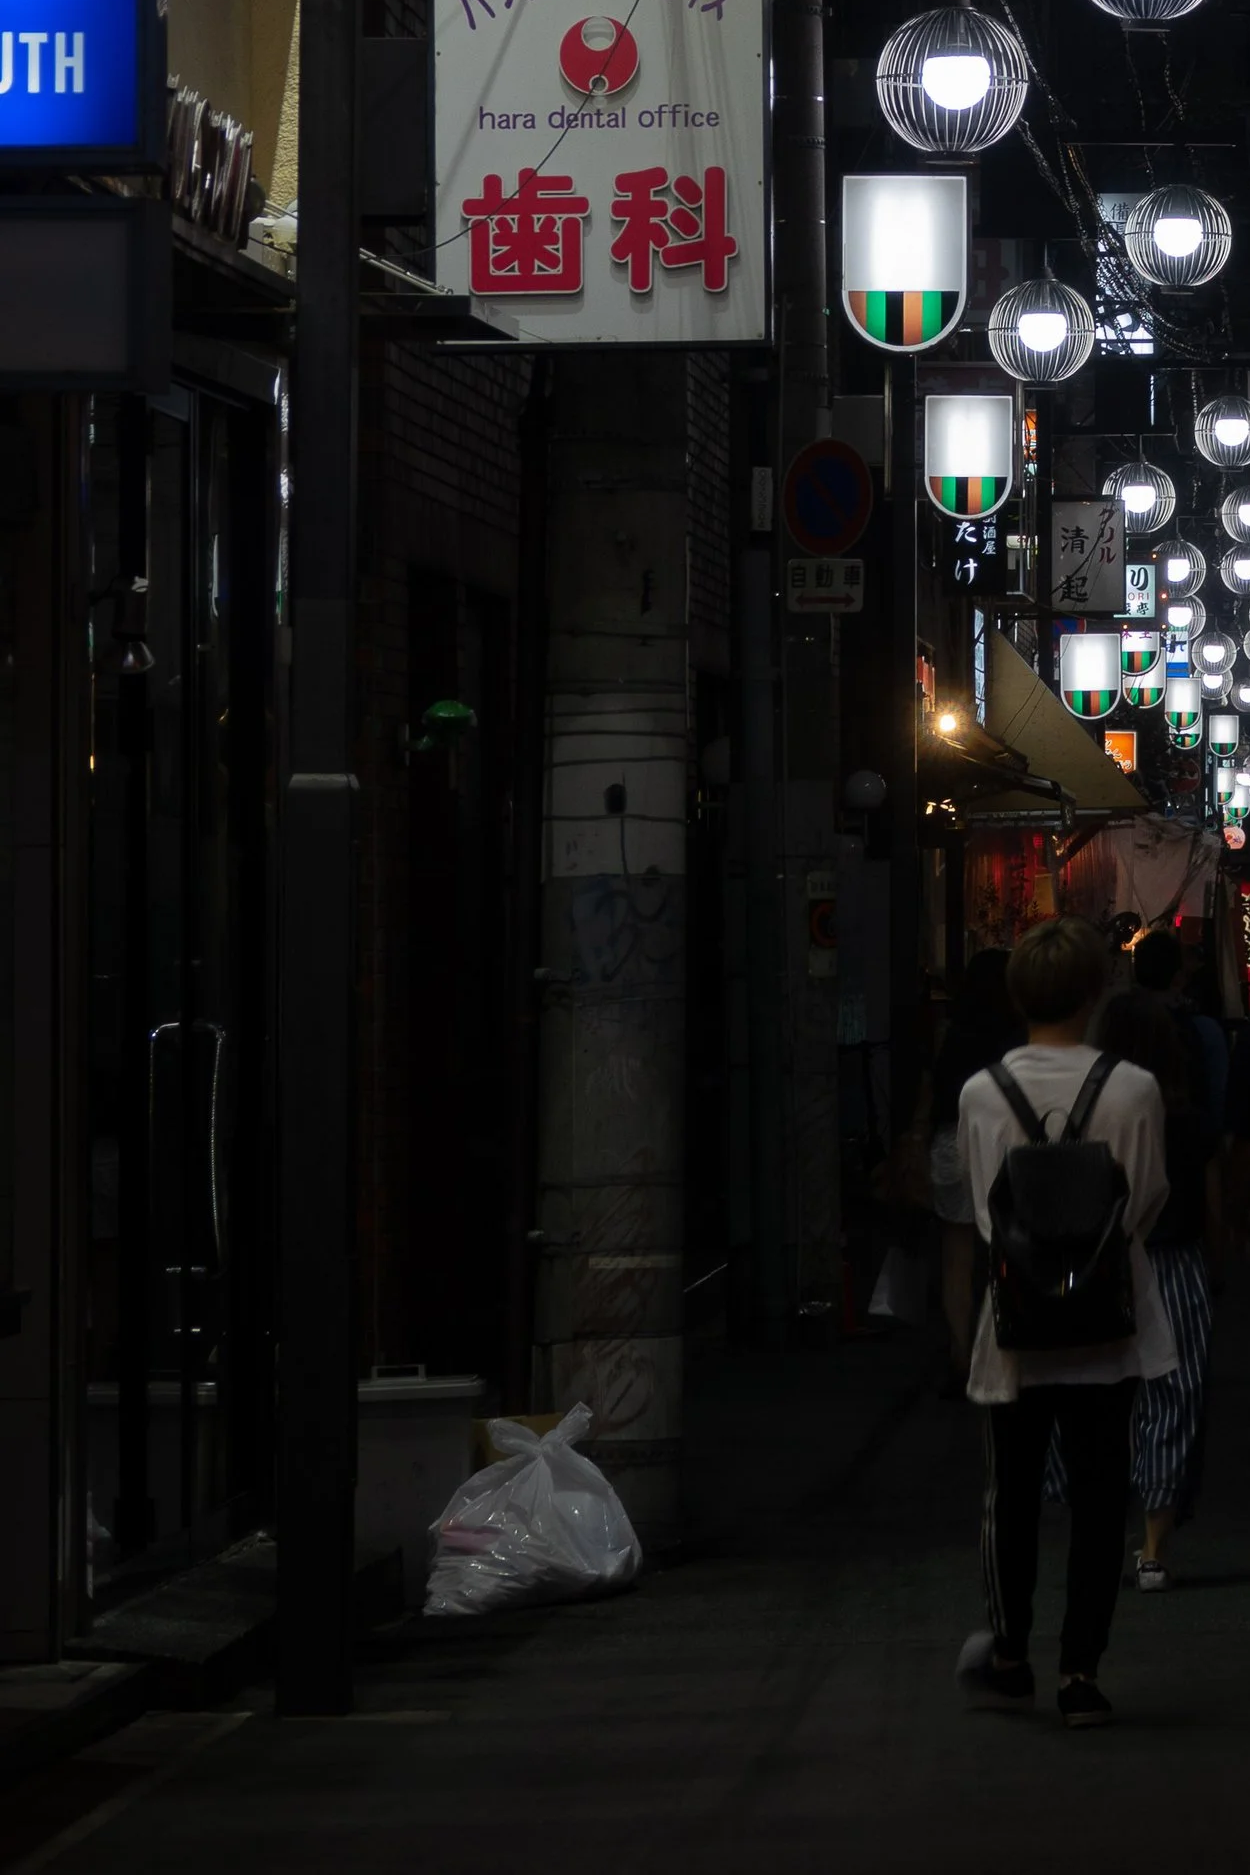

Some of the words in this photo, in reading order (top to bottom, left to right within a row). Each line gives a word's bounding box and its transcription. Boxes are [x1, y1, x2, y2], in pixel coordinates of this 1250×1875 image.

[479, 106, 536, 130] hara
[548, 105, 627, 130] dental
[638, 105, 720, 128] office
[461, 166, 738, 295] 歯科
[954, 521, 979, 585] たけ
[791, 565, 861, 589] 自動車
